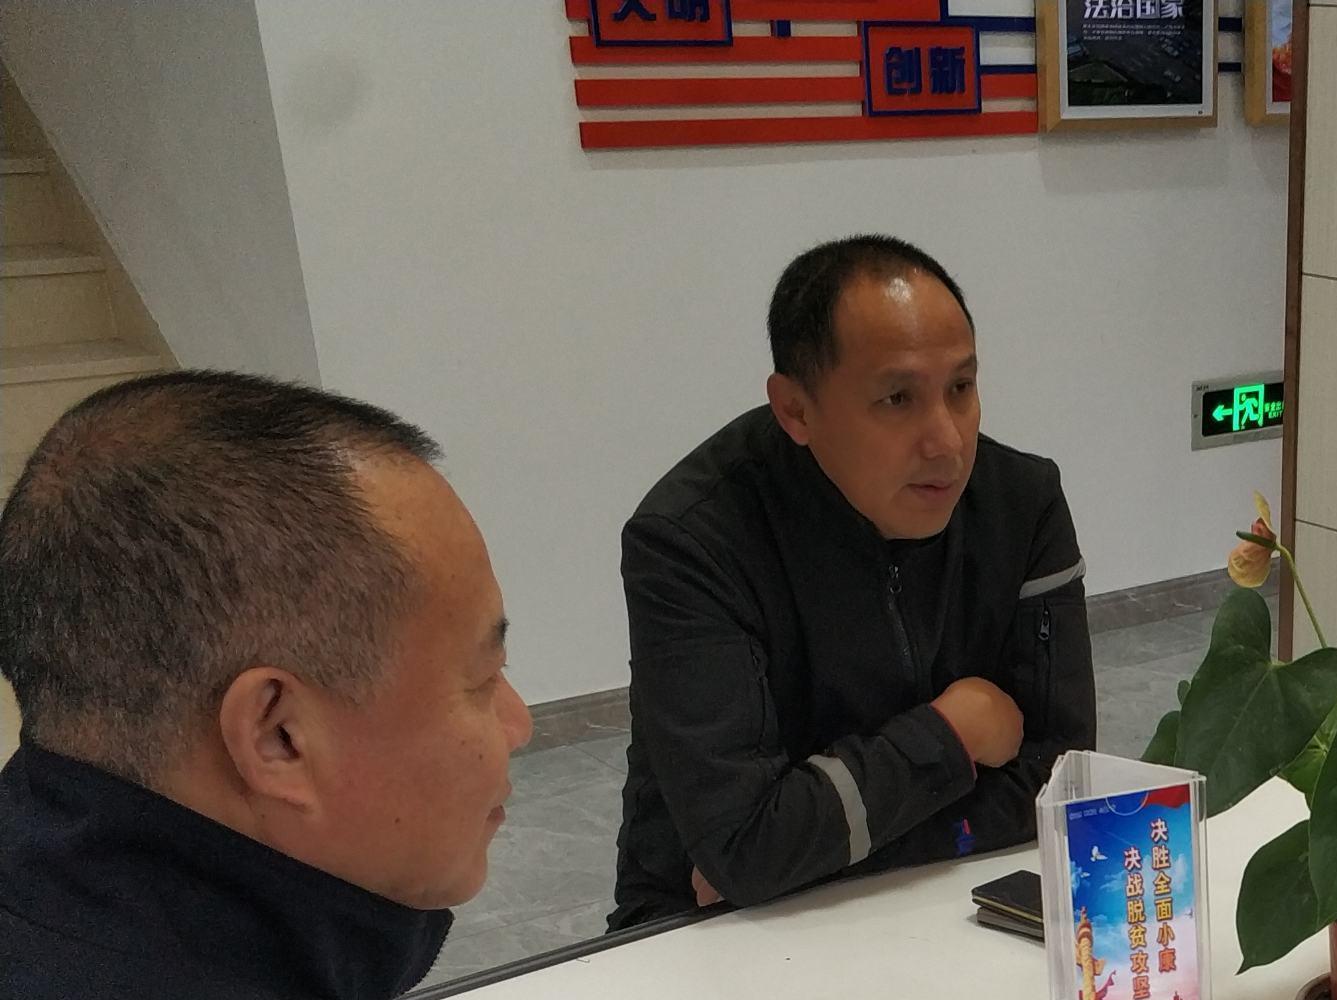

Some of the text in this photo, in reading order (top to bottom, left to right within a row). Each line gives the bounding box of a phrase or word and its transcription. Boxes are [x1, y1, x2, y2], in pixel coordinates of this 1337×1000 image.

[884, 45, 966, 95] 创新
[1124, 846, 1151, 1000] 决战脱贫攻坚
[1150, 817, 1177, 974] 决胜全面小康
